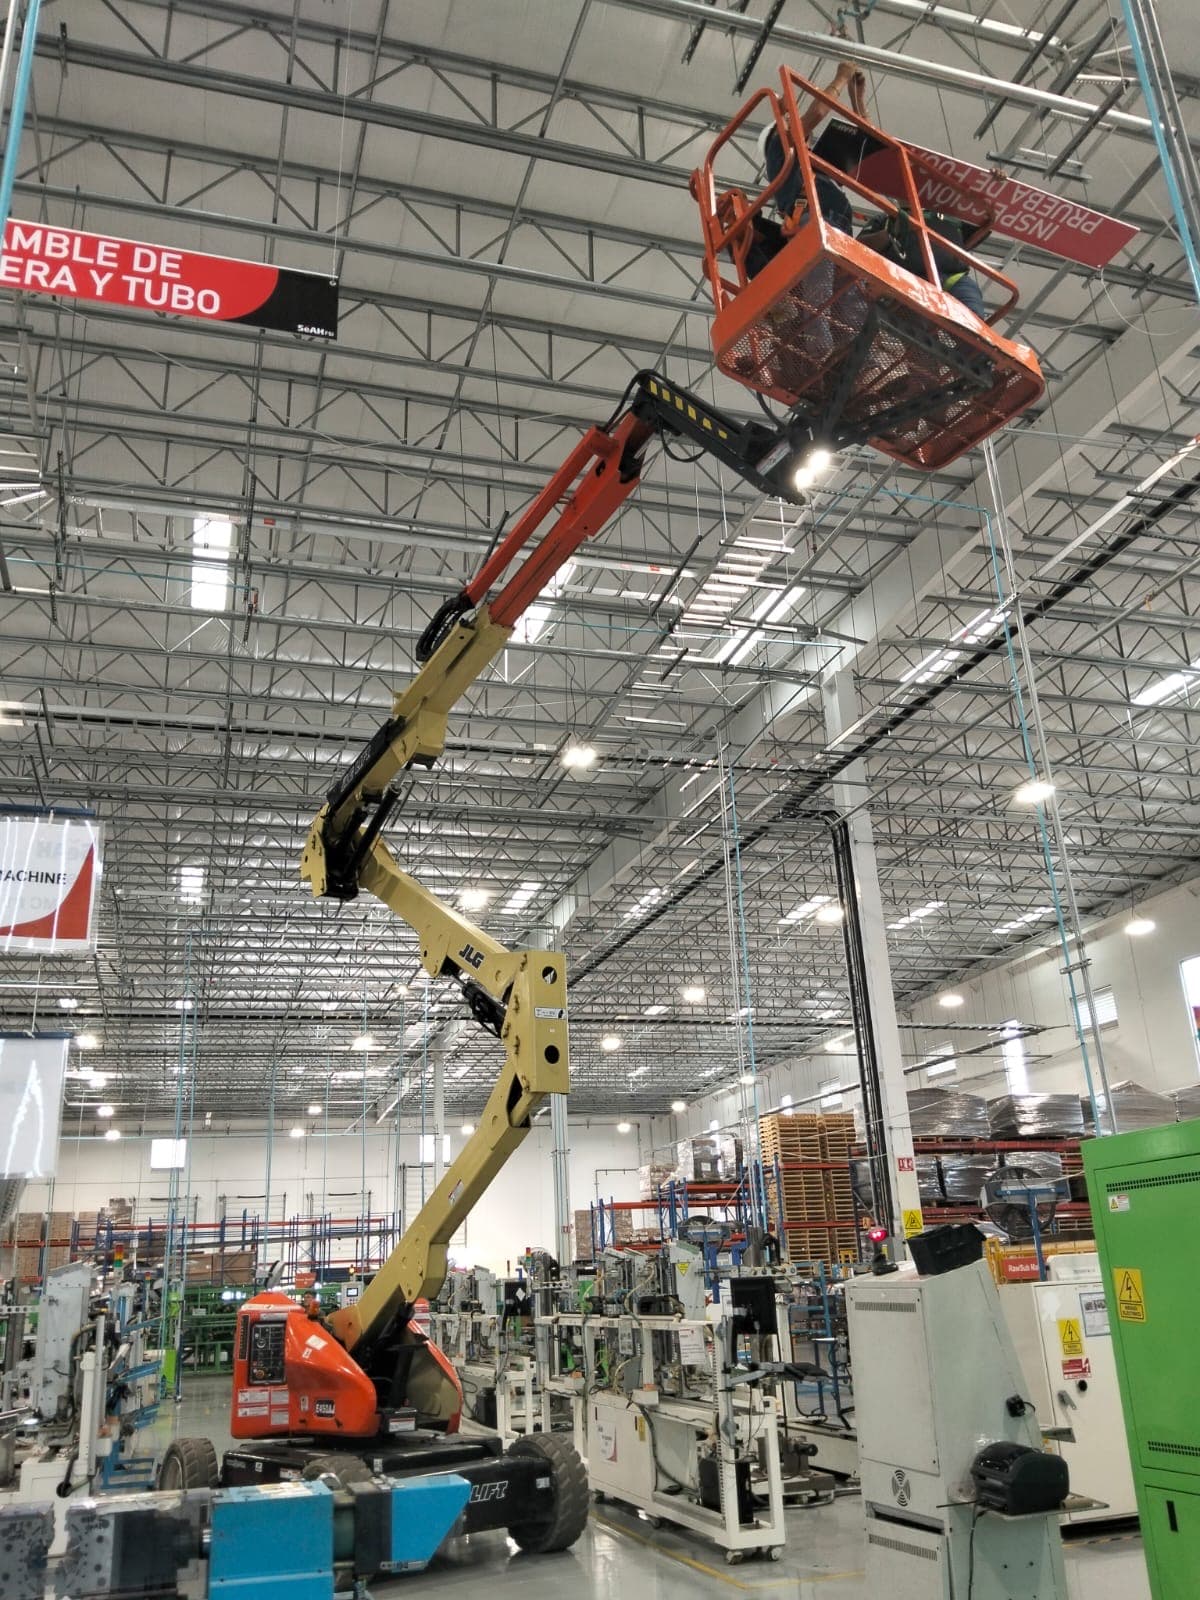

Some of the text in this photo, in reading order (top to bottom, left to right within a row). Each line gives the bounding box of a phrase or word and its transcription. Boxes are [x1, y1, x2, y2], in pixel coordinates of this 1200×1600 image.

[969, 172, 1009, 198] DE
[1010, 184, 1104, 235] PRUEBA
[132, 247, 182, 279] DE
[0, 255, 220, 315] ERA Y TUBO
[0, 869, 67, 885] ACHINE
[458, 943, 485, 970] JLG
[470, 1480, 508, 1503] LIFT
